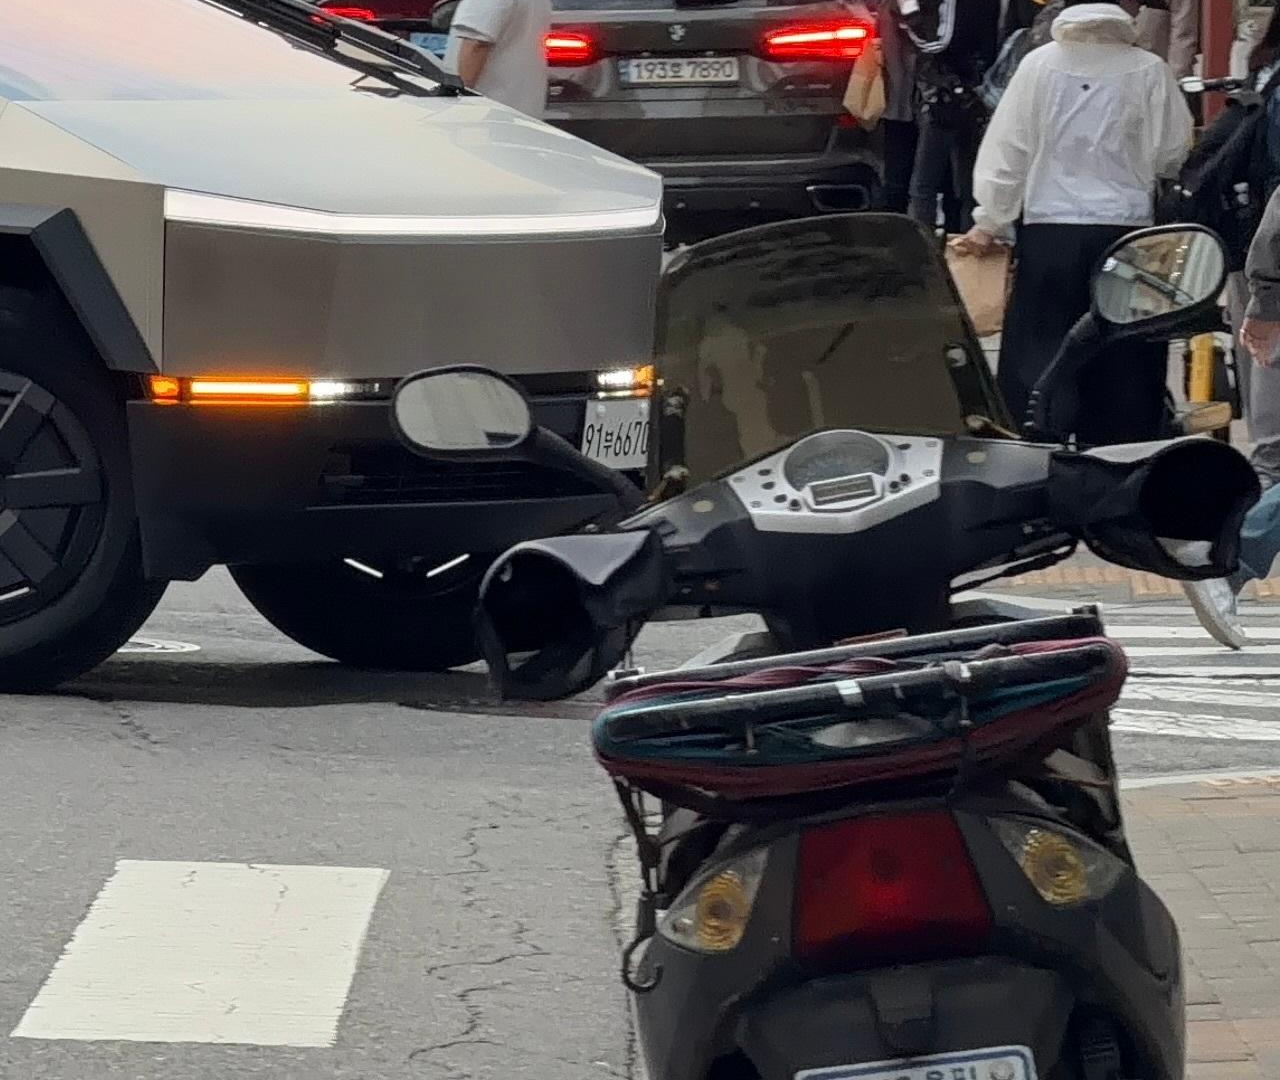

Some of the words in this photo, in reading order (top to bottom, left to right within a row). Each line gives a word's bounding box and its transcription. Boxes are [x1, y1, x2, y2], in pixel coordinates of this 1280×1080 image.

[633, 62, 683, 79] 193호
[686, 61, 734, 78] 7890
[585, 421, 651, 459] 91부6670
